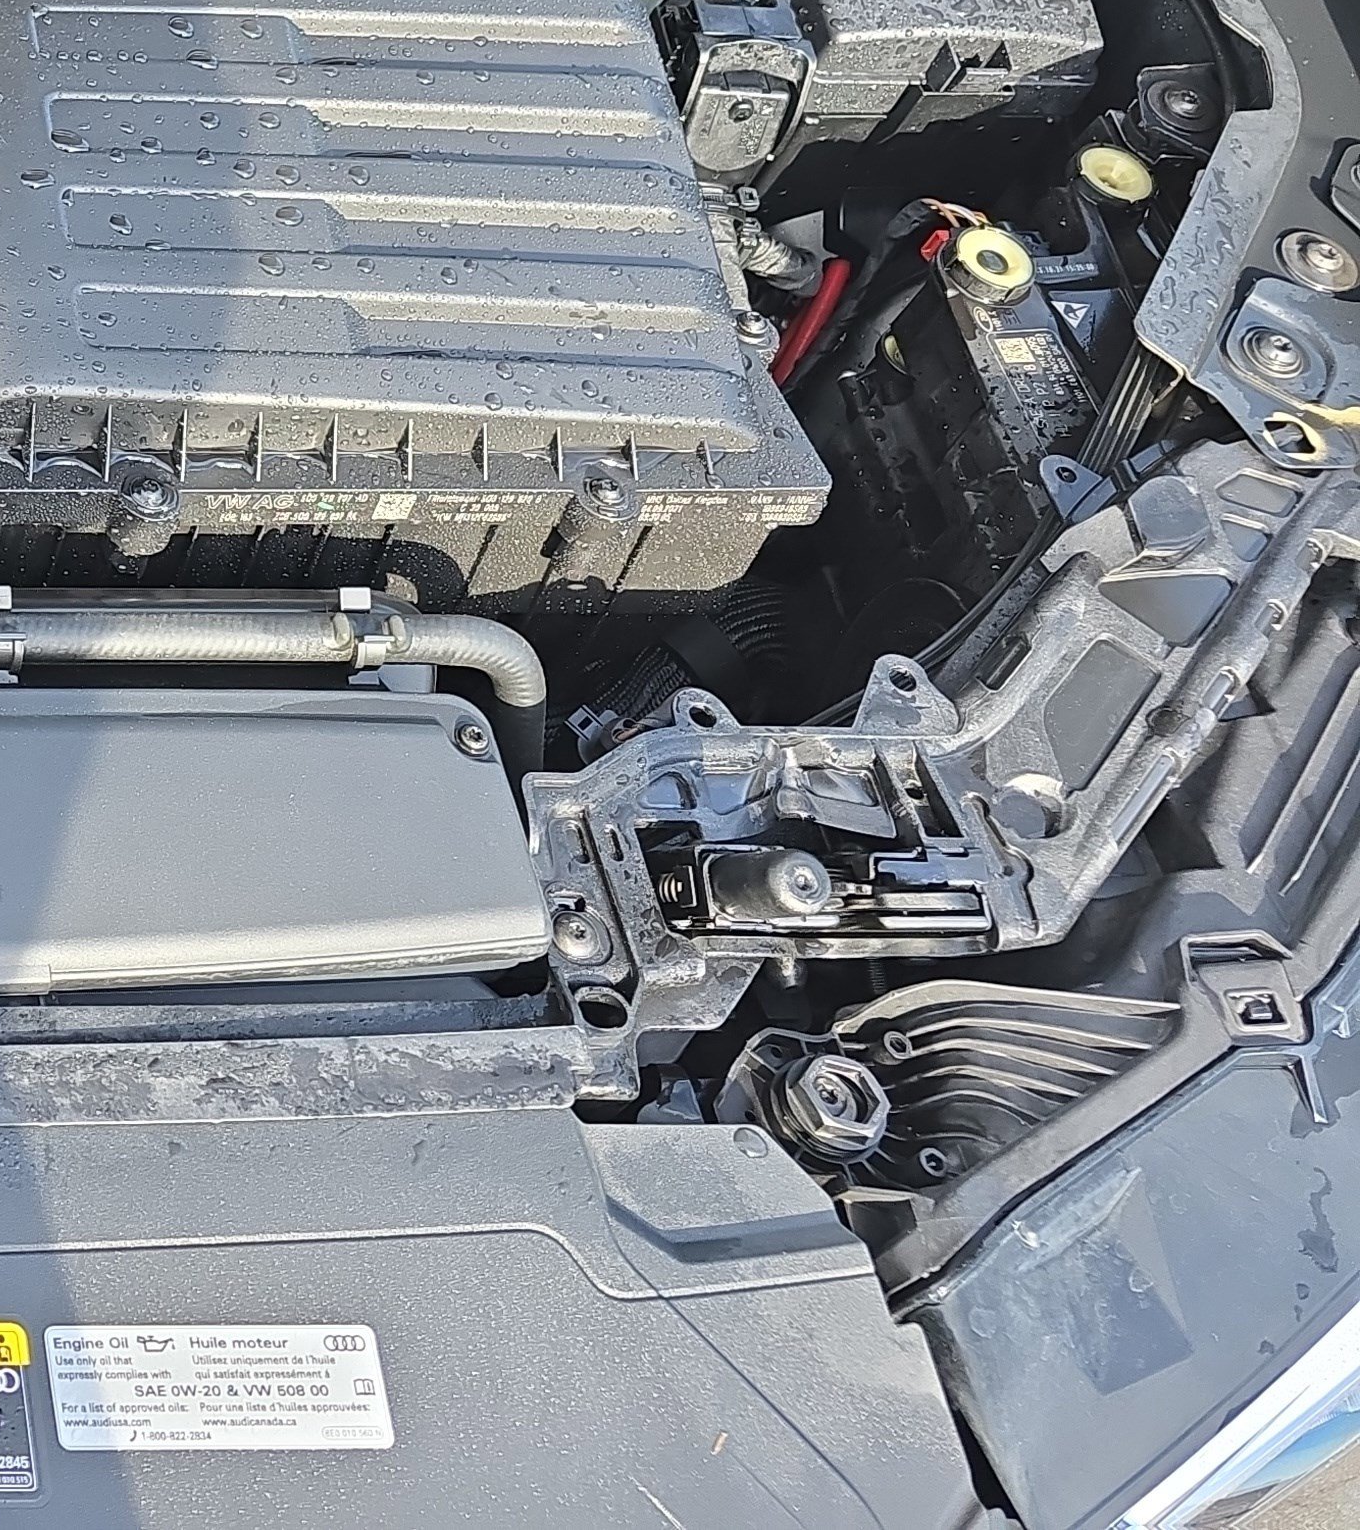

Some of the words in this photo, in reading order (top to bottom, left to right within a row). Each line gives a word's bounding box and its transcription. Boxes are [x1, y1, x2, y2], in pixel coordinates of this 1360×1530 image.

[1023, 364, 1040, 375] 18
[206, 494, 252, 510] VW
[252, 495, 296, 511] AG
[53, 1337, 104, 1351] Engine
[109, 1337, 129, 1349] Oil
[189, 1337, 227, 1349] Huile
[232, 1337, 288, 1349] moteur
[55, 1355, 74, 1366] Use
[76, 1355, 97, 1367] only
[100, 1356, 111, 1365] oil
[113, 1355, 133, 1365] that
[192, 1355, 227, 1365] Utilisez
[230, 1355, 288, 1367] uniquement
[291, 1355, 303, 1365] de
[58, 1370, 102, 1382] expressly
[105, 1369, 149, 1381] complies
[150, 1369, 172, 1379] with
[195, 1369, 211, 1380] qui
[213, 1369, 251, 1379] satisfait
[253, 1368, 322, 1380] expressément
[134, 1384, 167, 1397] SAE
[170, 1384, 221, 1397] 0W-20
[227, 1384, 239, 1397] &
[243, 1384, 272, 1397] VW
[277, 1384, 306, 1397] 508
[310, 1384, 329, 1397] 00
[61, 1402, 78, 1413] For
[80, 1405, 87, 1413] a
[88, 1402, 104, 1412] list
[106, 1402, 117, 1412] of
[119, 1402, 166, 1414] approved
[199, 1402, 223, 1412] Pour
[225, 1403, 243, 1412] une
[245, 1402, 267, 1412] liste
[64, 1417, 151, 1427] www.audiusa.com
[202, 1417, 297, 1426] www.audicanada.ca
[141, 1431, 211, 1441] 1-800-822-2834
